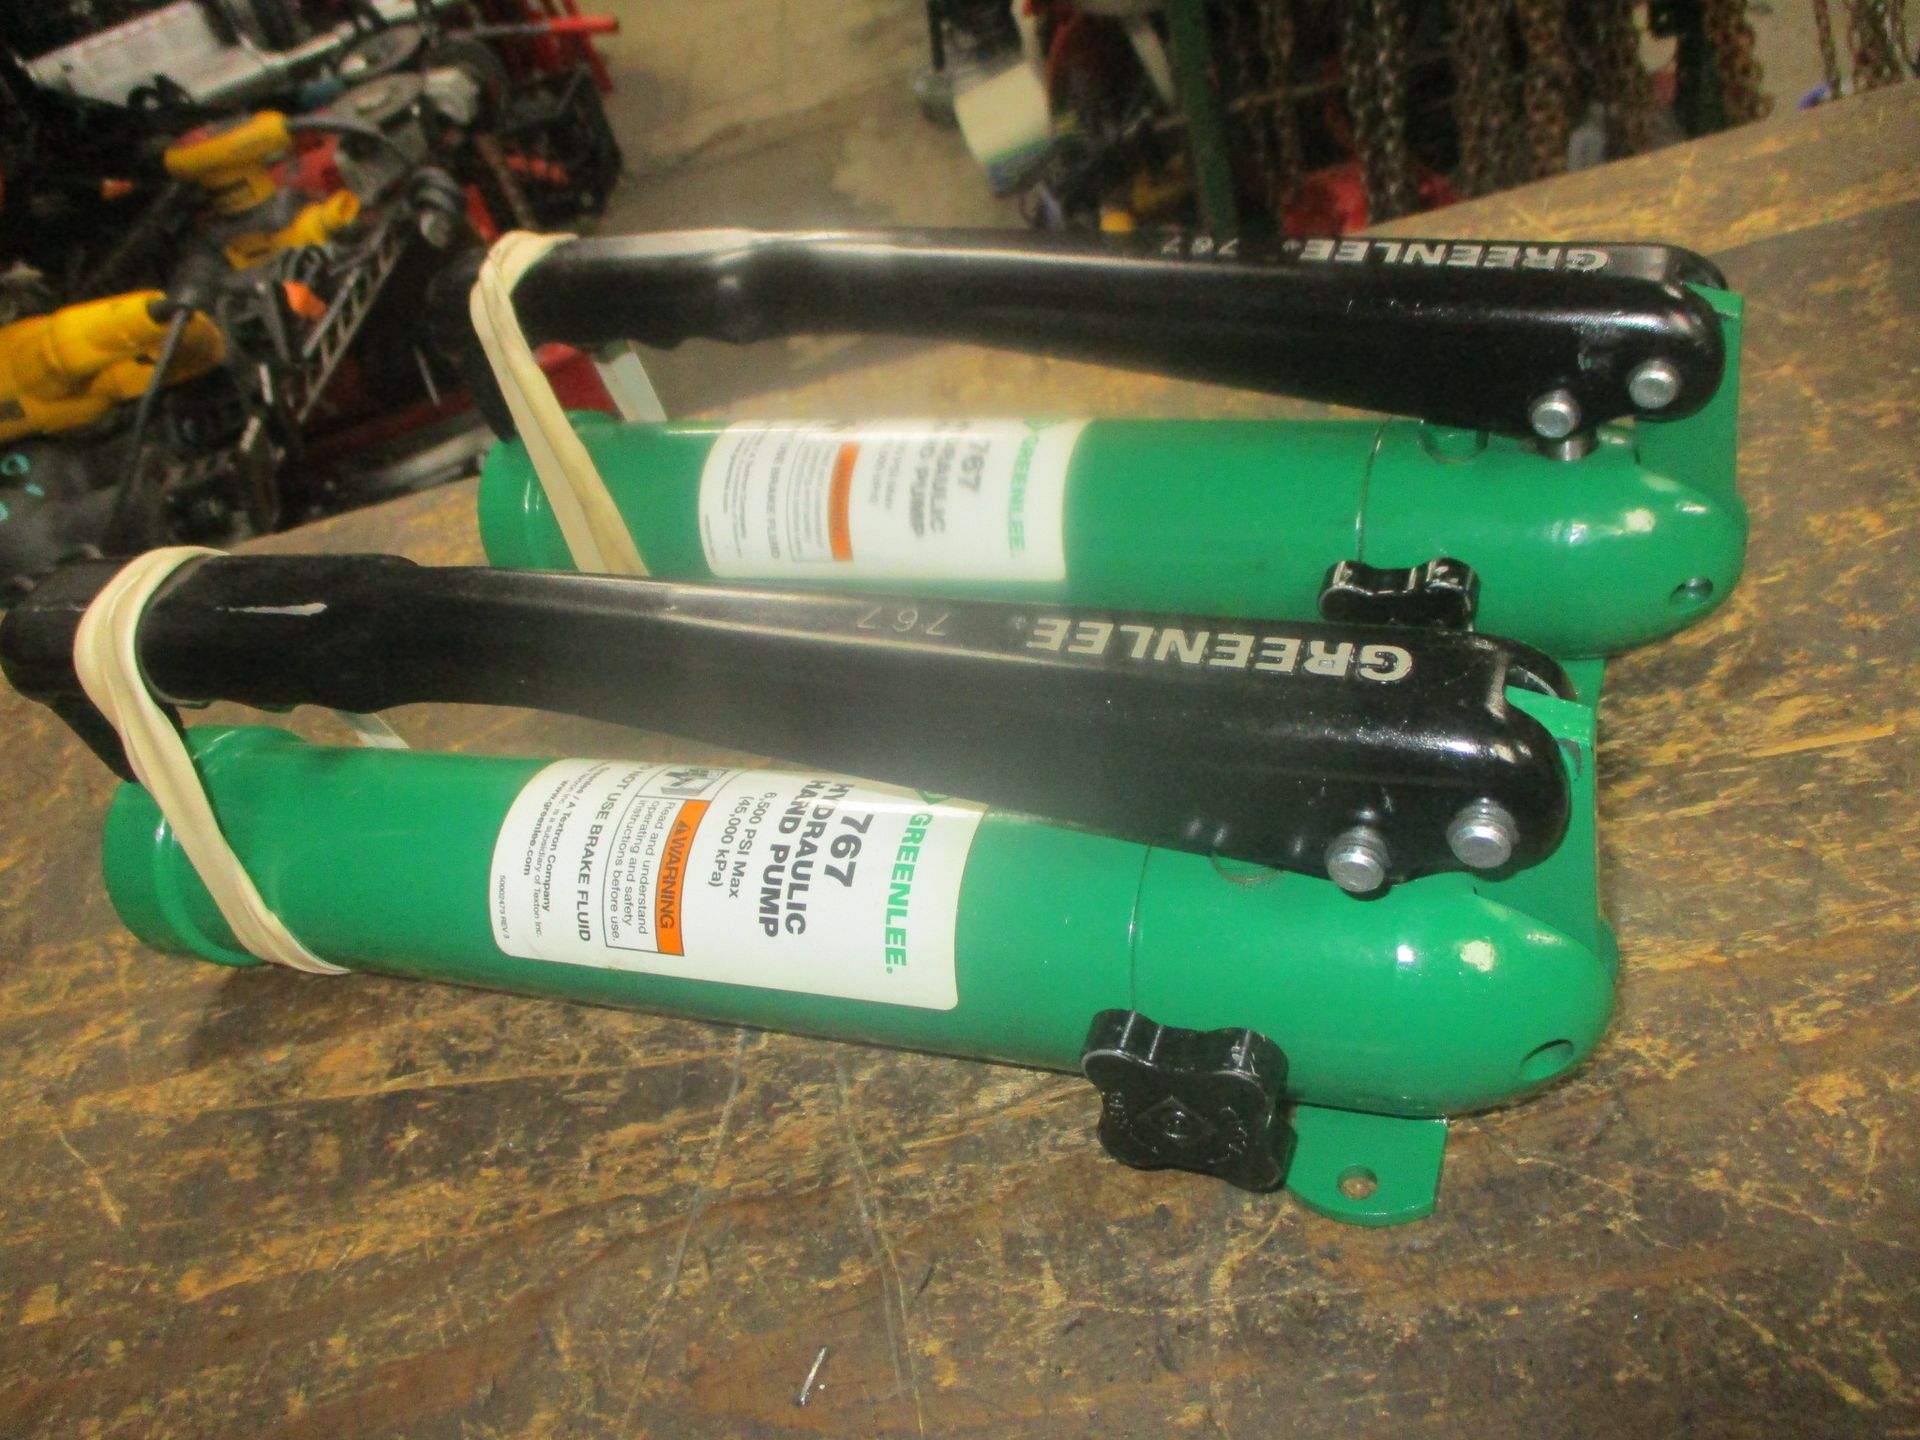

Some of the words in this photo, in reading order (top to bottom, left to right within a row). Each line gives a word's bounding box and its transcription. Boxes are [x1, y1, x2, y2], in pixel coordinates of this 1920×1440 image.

[857, 607, 950, 636] 767
[523, 779, 568, 875] www.greenlee.com
[595, 792, 622, 820] USE
[630, 801, 659, 854] operating
[655, 802, 676, 829] Read
[721, 796, 755, 844] (45,000
[749, 792, 777, 824] 6,500
[777, 780, 831, 835] HAND
[534, 825, 552, 872] subsidiary
[550, 811, 572, 851] Textron
[615, 800, 646, 866] instructions
[646, 832, 658, 856] and
[737, 828, 757, 854] PSI
[823, 813, 874, 887] 767
[577, 824, 603, 884] BRAKE
[626, 857, 637, 882] and
[708, 849, 731, 887] kPa)
[784, 783, 855, 935] HYDRAULIC
[534, 874, 541, 885] of
[542, 854, 556, 912] Company
[610, 870, 623, 912] before
[637, 860, 651, 934] understand
[660, 836, 688, 929] WARNING
[728, 860, 747, 899] Max
[758, 844, 791, 938] PUMP
[576, 890, 591, 941] FLUID
[610, 915, 620, 941] use.
[622, 886, 634, 926] safety
